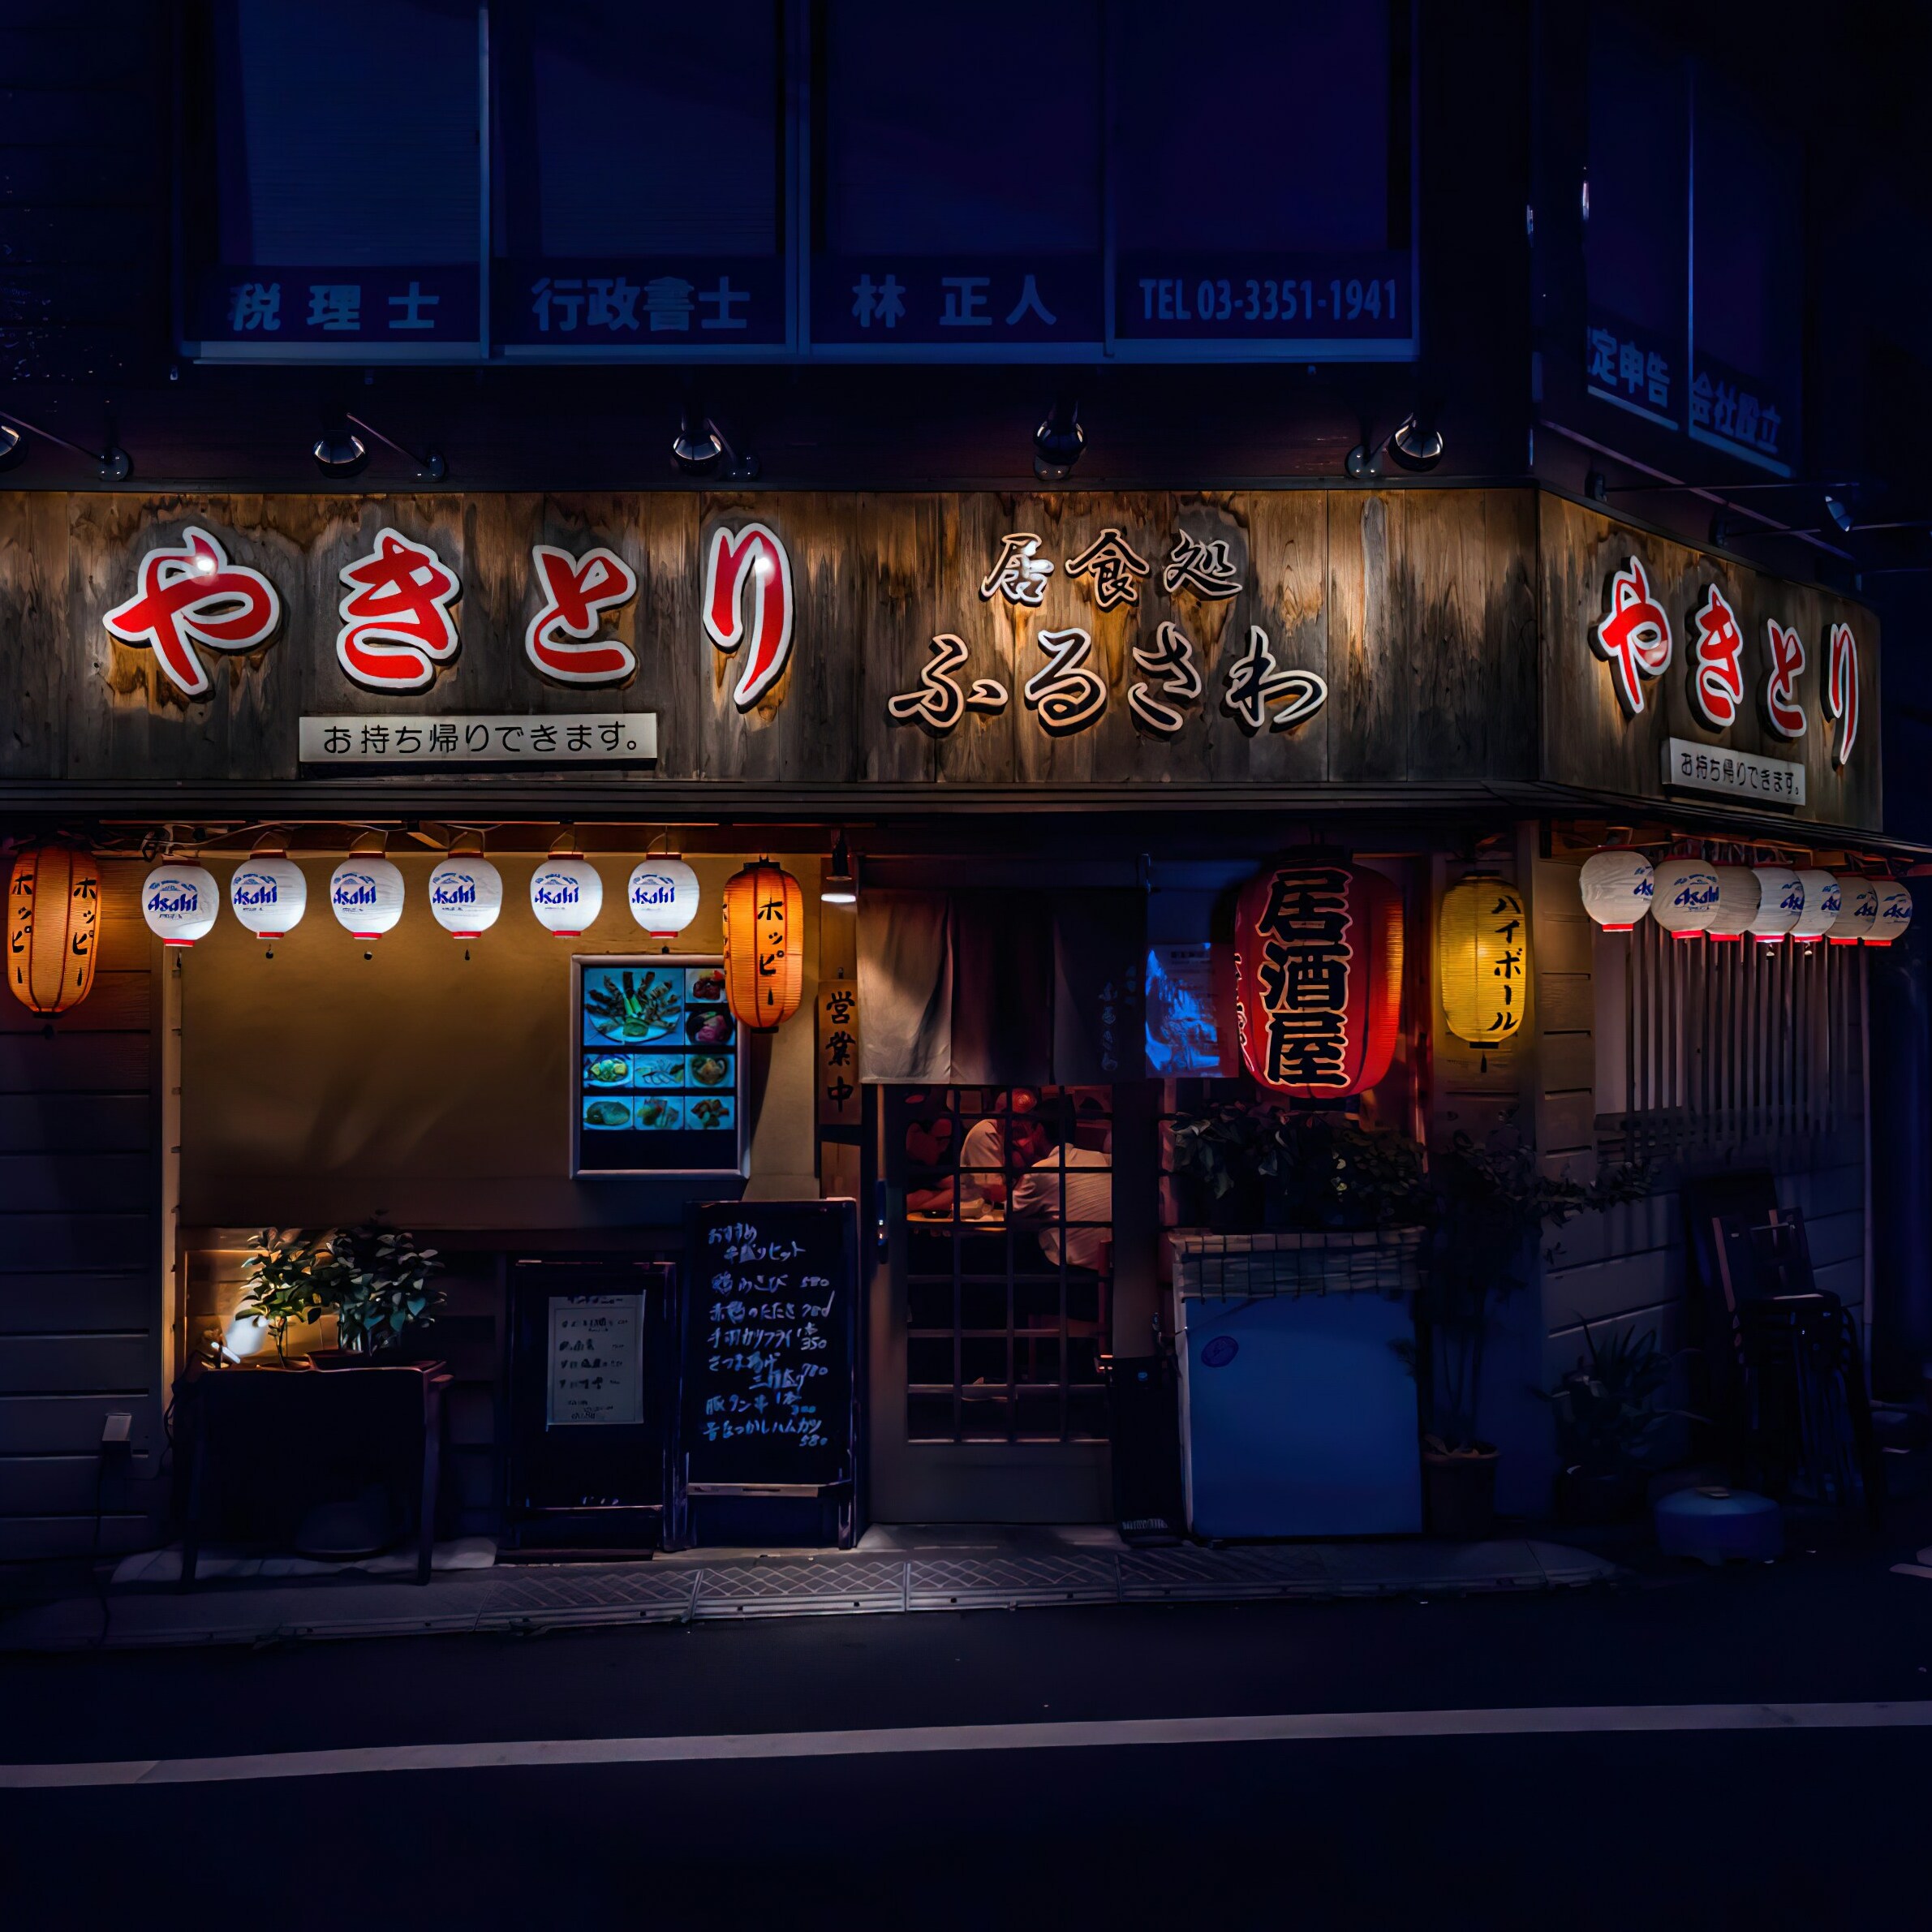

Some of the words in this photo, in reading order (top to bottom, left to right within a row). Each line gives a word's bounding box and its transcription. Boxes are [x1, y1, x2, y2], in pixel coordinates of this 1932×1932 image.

[228, 280, 440, 332] 税理士
[531, 275, 751, 332] 行政書士
[1138, 278, 1191, 321] TEL
[1197, 278, 1397, 321] 03-3351-1941
[1587, 325, 1671, 409] 定申告
[103, 523, 795, 709] やきとり
[1596, 555, 1859, 765] やきとり
[888, 621, 1328, 733] ふるさわ
[324, 721, 637, 754] お持ち帰りできます。
[12, 872, 33, 984] ホッピー
[73, 878, 97, 986] ホッピー
[148, 893, 198, 912] Asahi
[234, 885, 278, 905] Asahi
[333, 885, 377, 905] Asahi
[432, 885, 475, 904] Asahi
[758, 897, 785, 1005] ホッピー
[1255, 867, 1353, 1088] 居酒屋
[1487, 895, 1522, 1031] ハイボール
[826, 992, 855, 1112] 営業中
